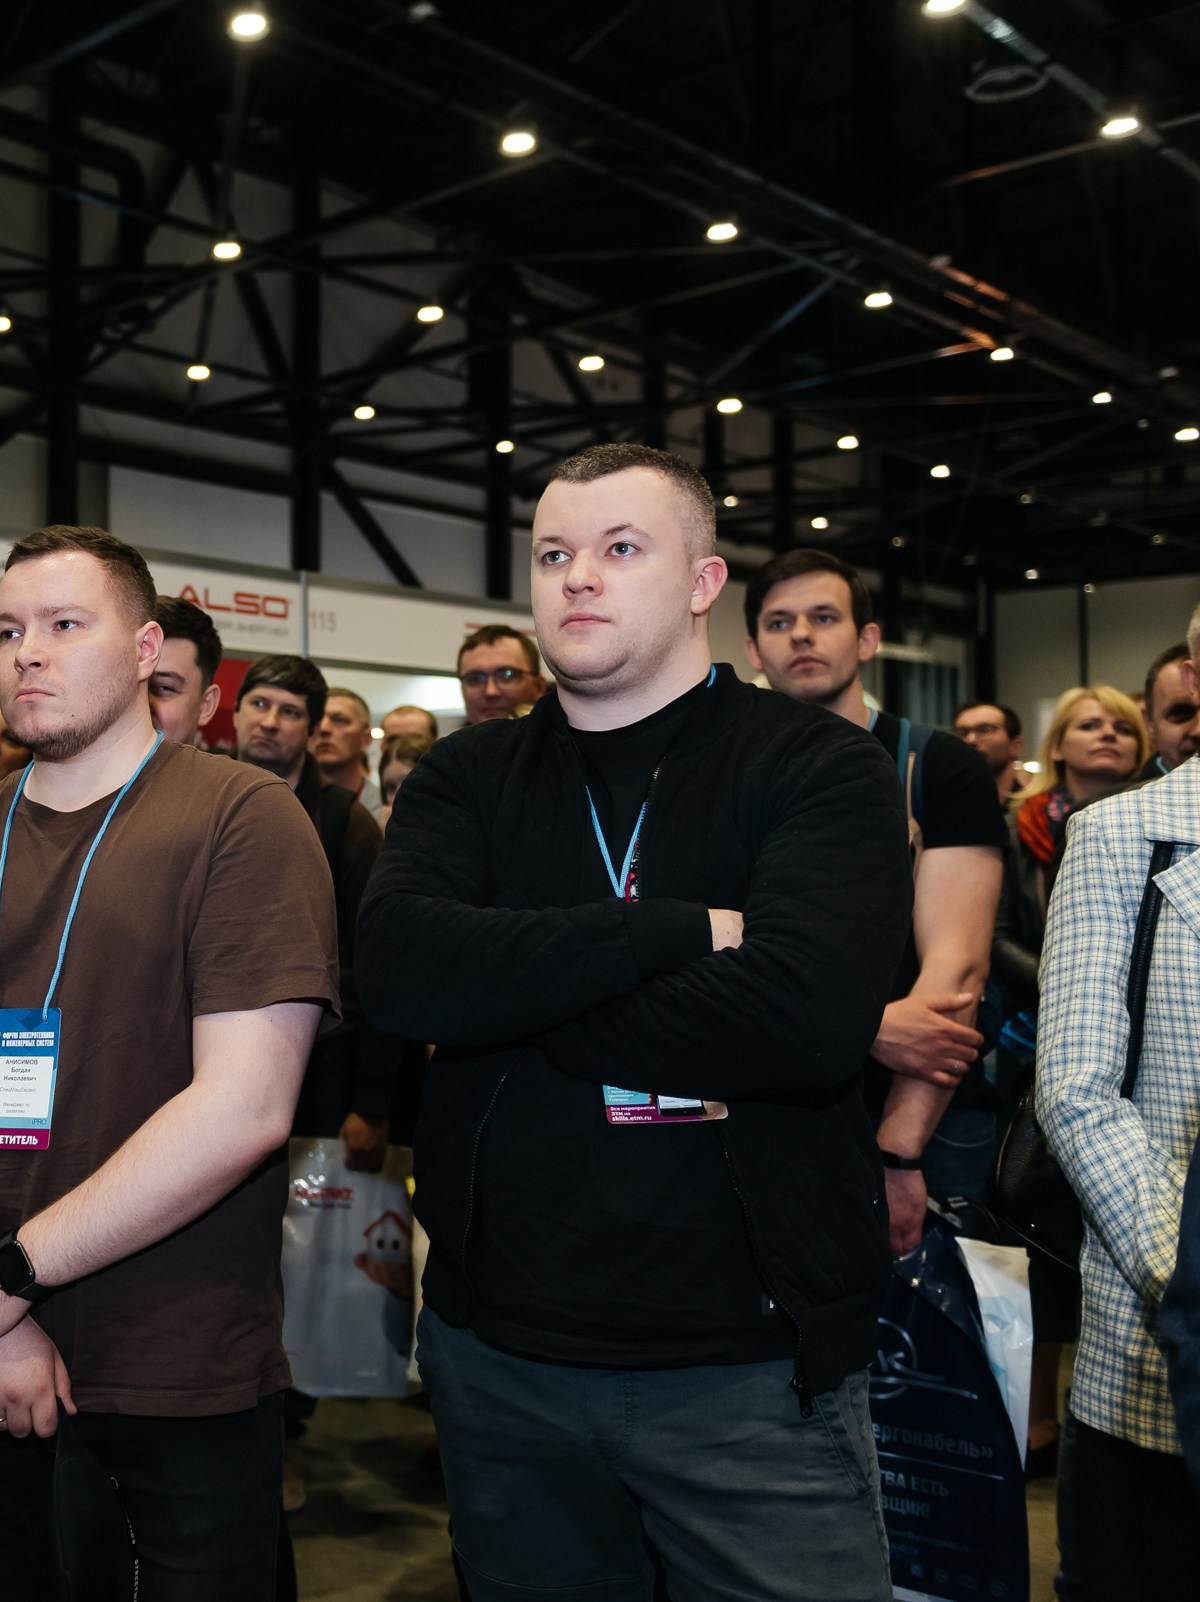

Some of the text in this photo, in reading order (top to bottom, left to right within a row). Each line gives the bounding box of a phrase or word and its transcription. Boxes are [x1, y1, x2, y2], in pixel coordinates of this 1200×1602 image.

[178, 584, 290, 620] ALSO
[871, 1421, 994, 1459] ергокабель»
[910, 1474, 950, 1498] ЕСТЬ
